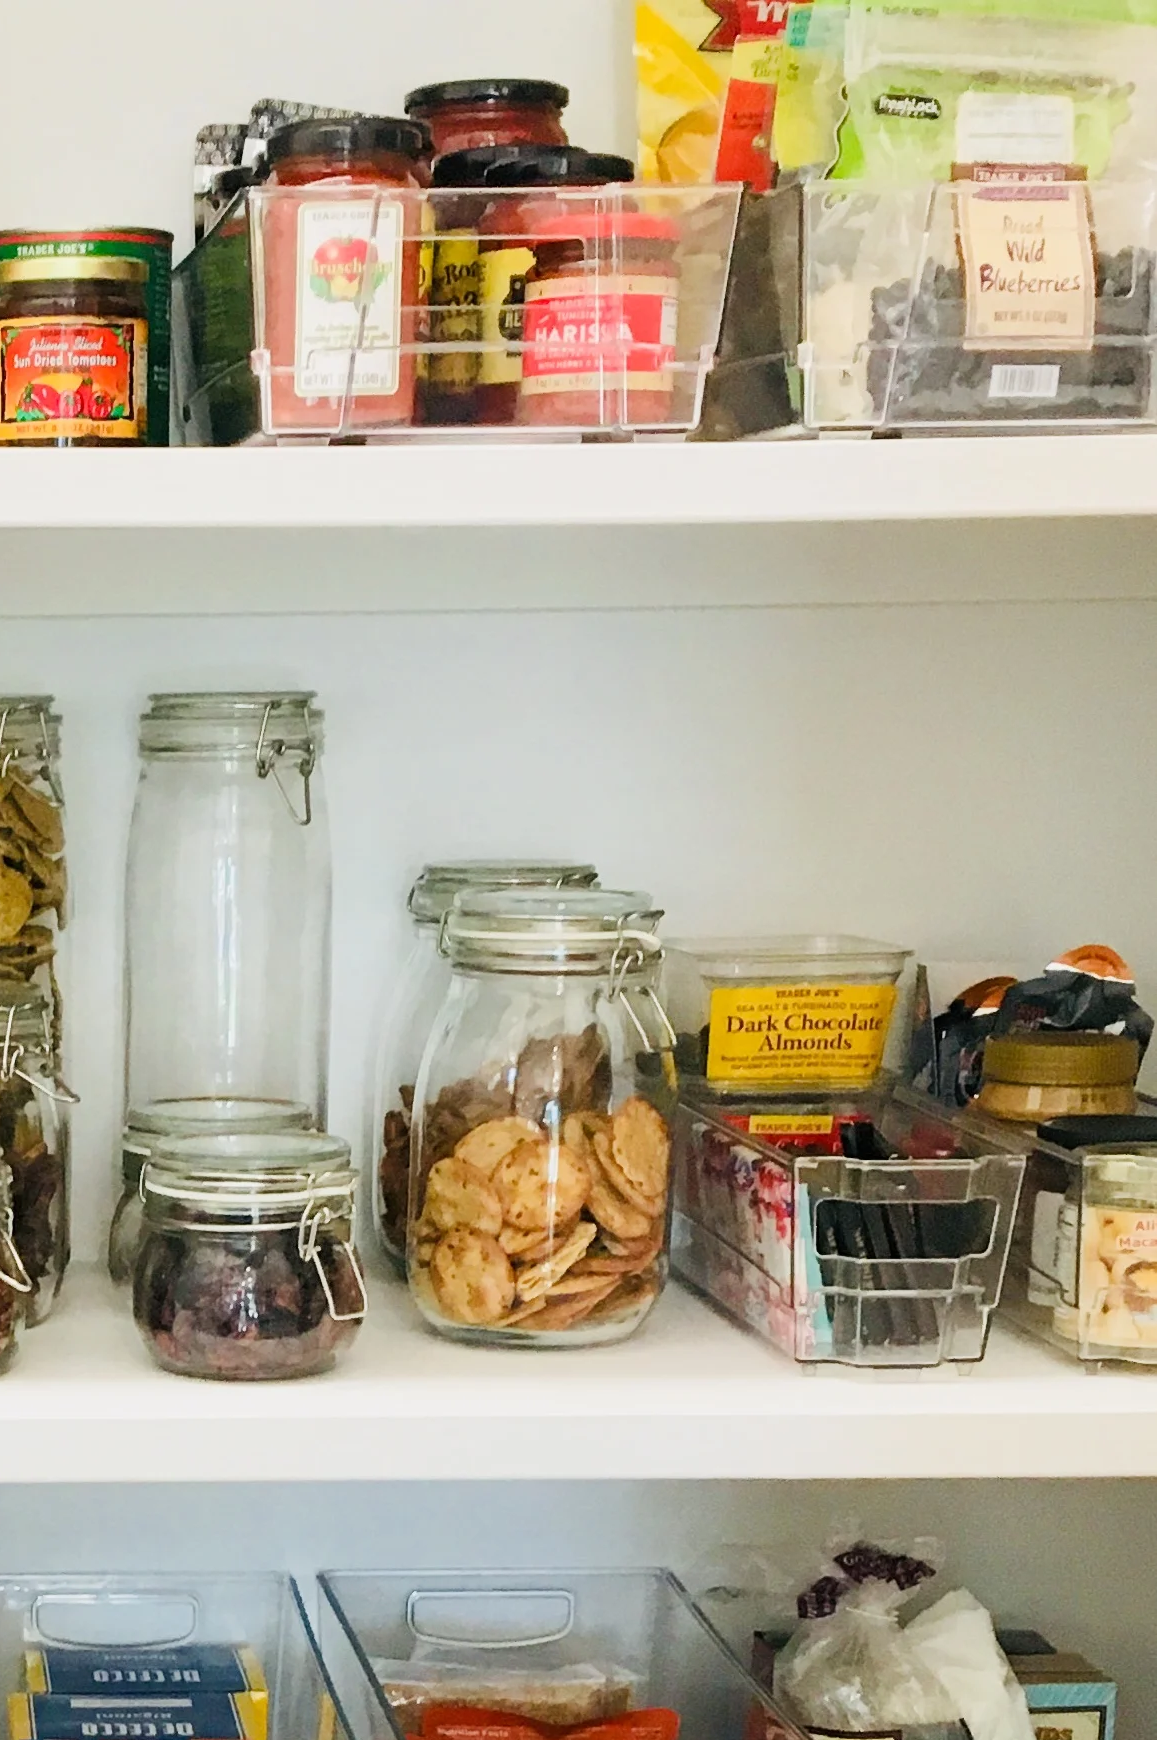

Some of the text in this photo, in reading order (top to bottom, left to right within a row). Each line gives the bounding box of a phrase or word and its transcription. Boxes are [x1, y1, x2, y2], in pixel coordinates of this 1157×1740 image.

[17, 243, 87, 256] TRADER JOE'S
[1006, 238, 1046, 264] Wild
[980, 263, 1081, 295] Blueberries
[14, 354, 117, 368] Sun Dried Tomatoes
[776, 989, 811, 999] TRADER
[736, 1003, 755, 1012] SEA
[758, 1002, 781, 1012] SALT
[849, 1001, 880, 1011] SUGAR
[726, 1013, 885, 1034] Dark Chocolate
[758, 1033, 853, 1053] Almonds
